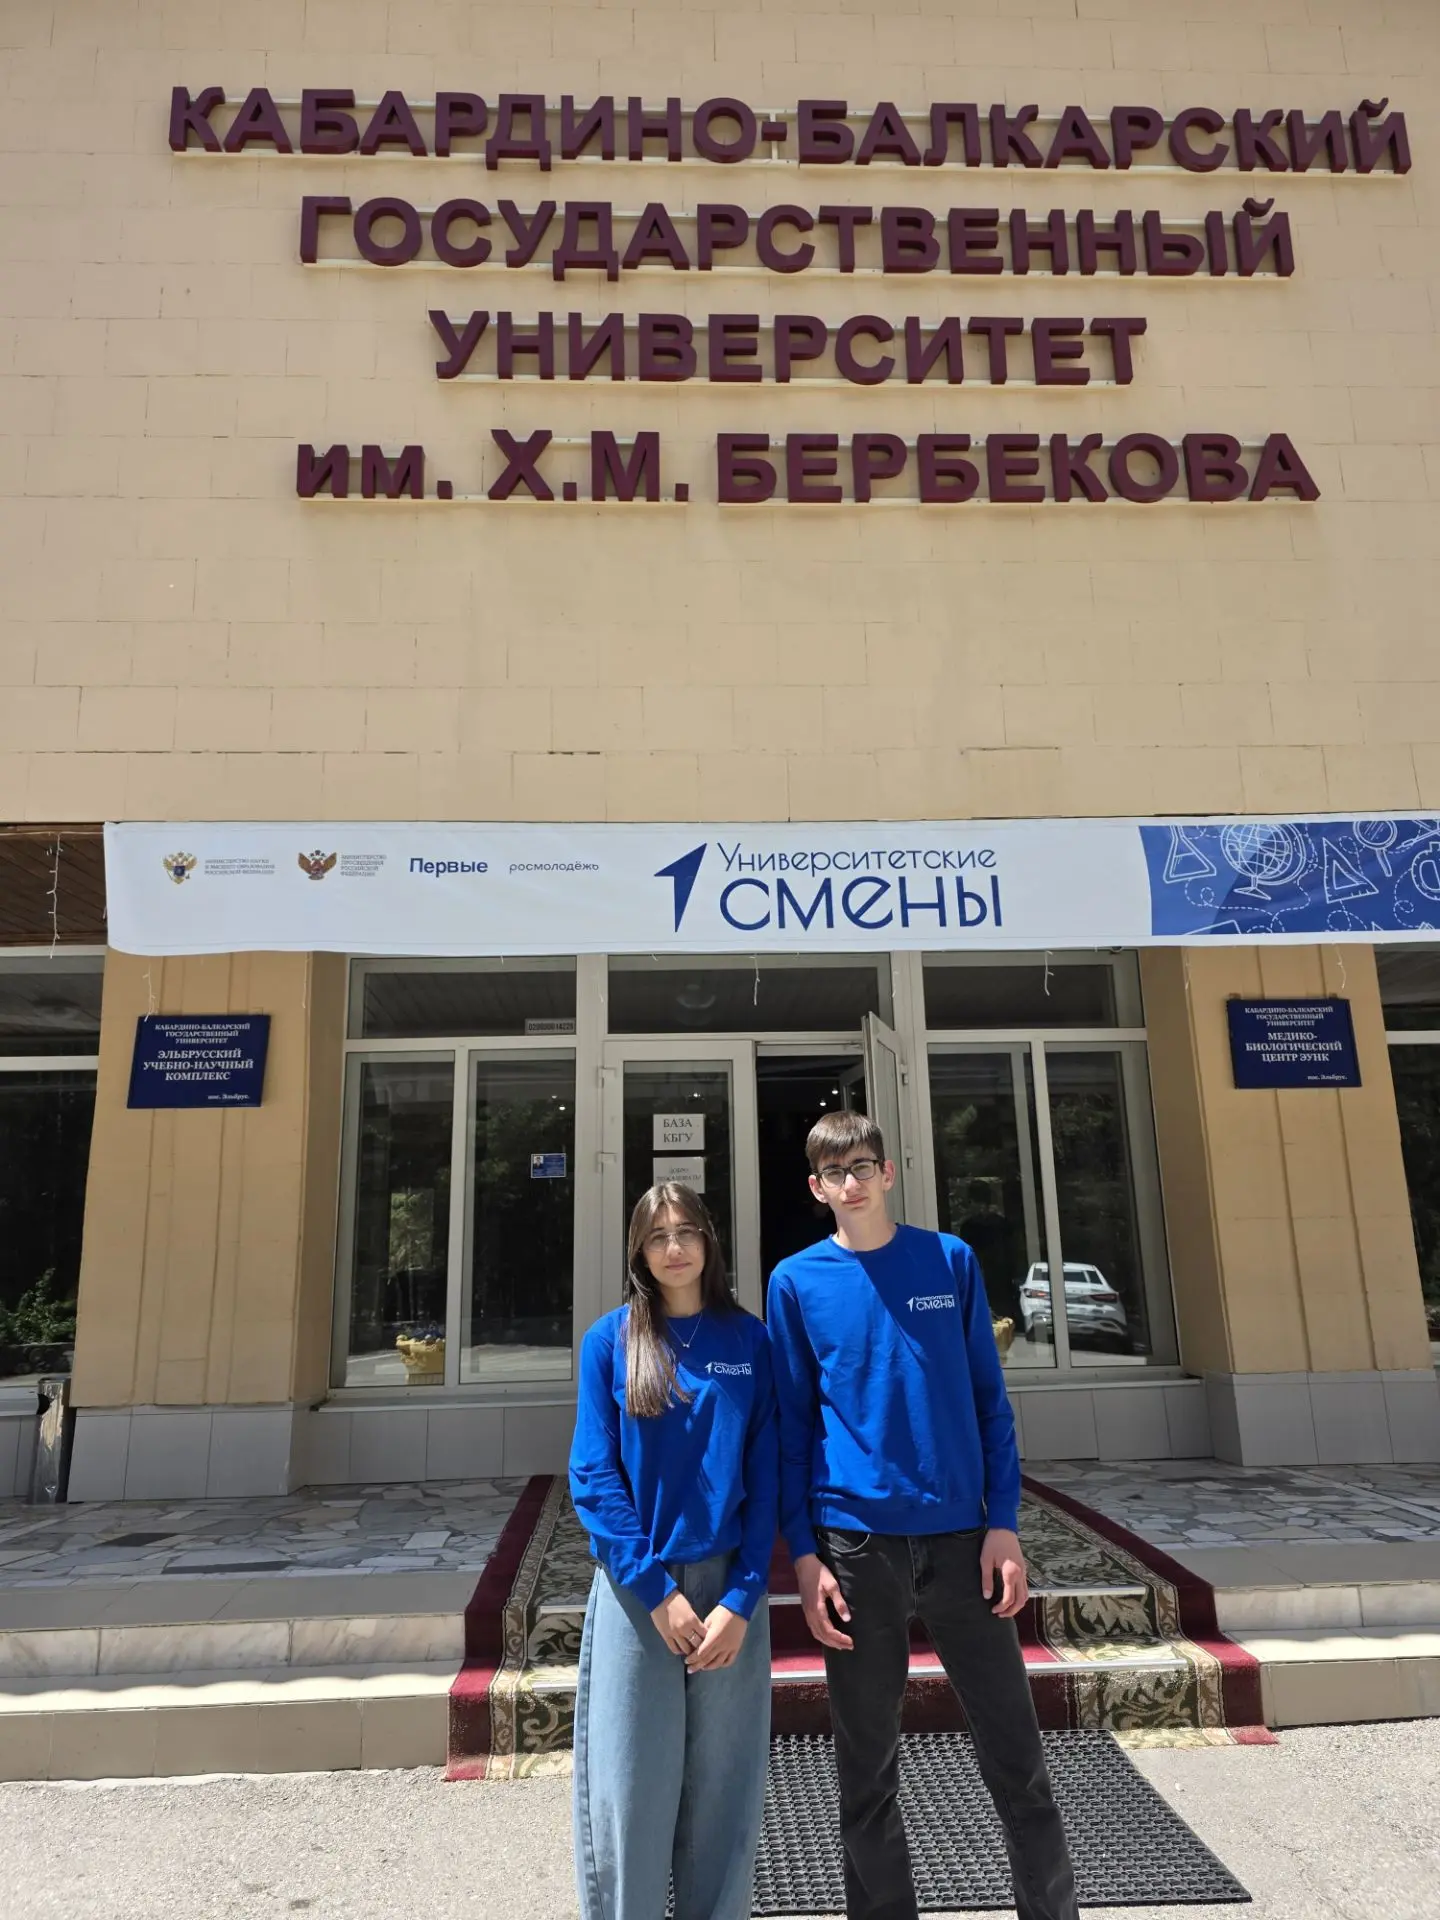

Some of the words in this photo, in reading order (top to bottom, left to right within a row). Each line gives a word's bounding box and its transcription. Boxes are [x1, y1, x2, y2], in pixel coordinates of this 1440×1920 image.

[168, 86, 1411, 174] КАБАРДИНО-БАЛКАРСКИЙ
[300, 195, 1295, 281] ГОСУДАРСТВЕННЫЙ
[428, 309, 1147, 385] УНИВЕРСИТЕТ
[488, 428, 689, 503] Х.М.
[717, 432, 1321, 503] БЕРБЕКОВА
[717, 842, 997, 877] Университетские
[409, 857, 488, 878] Первые
[509, 861, 599, 874] росмолодёжь
[1245, 1006, 1333, 1014] КАБАРДИНО-БАЛКАРСКИЙ
[1267, 1032, 1318, 1041] МЕДИКО-
[1245, 1041, 1342, 1051] БИОЛОГИЧЕСКИЙ
[157, 1048, 242, 1059] ЭЛЬБРУССКИЙ
[1262, 1054, 1298, 1063] ЦЕНТР
[1299, 1053, 1330, 1062] ЭУНК
[143, 1059, 254, 1071] УЧЕБНО-НАУЧНЫЙ
[165, 1072, 231, 1081] КОМПЛЕКС
[663, 1118, 693, 1128] БАЗА
[663, 1133, 694, 1143] КБГУ
